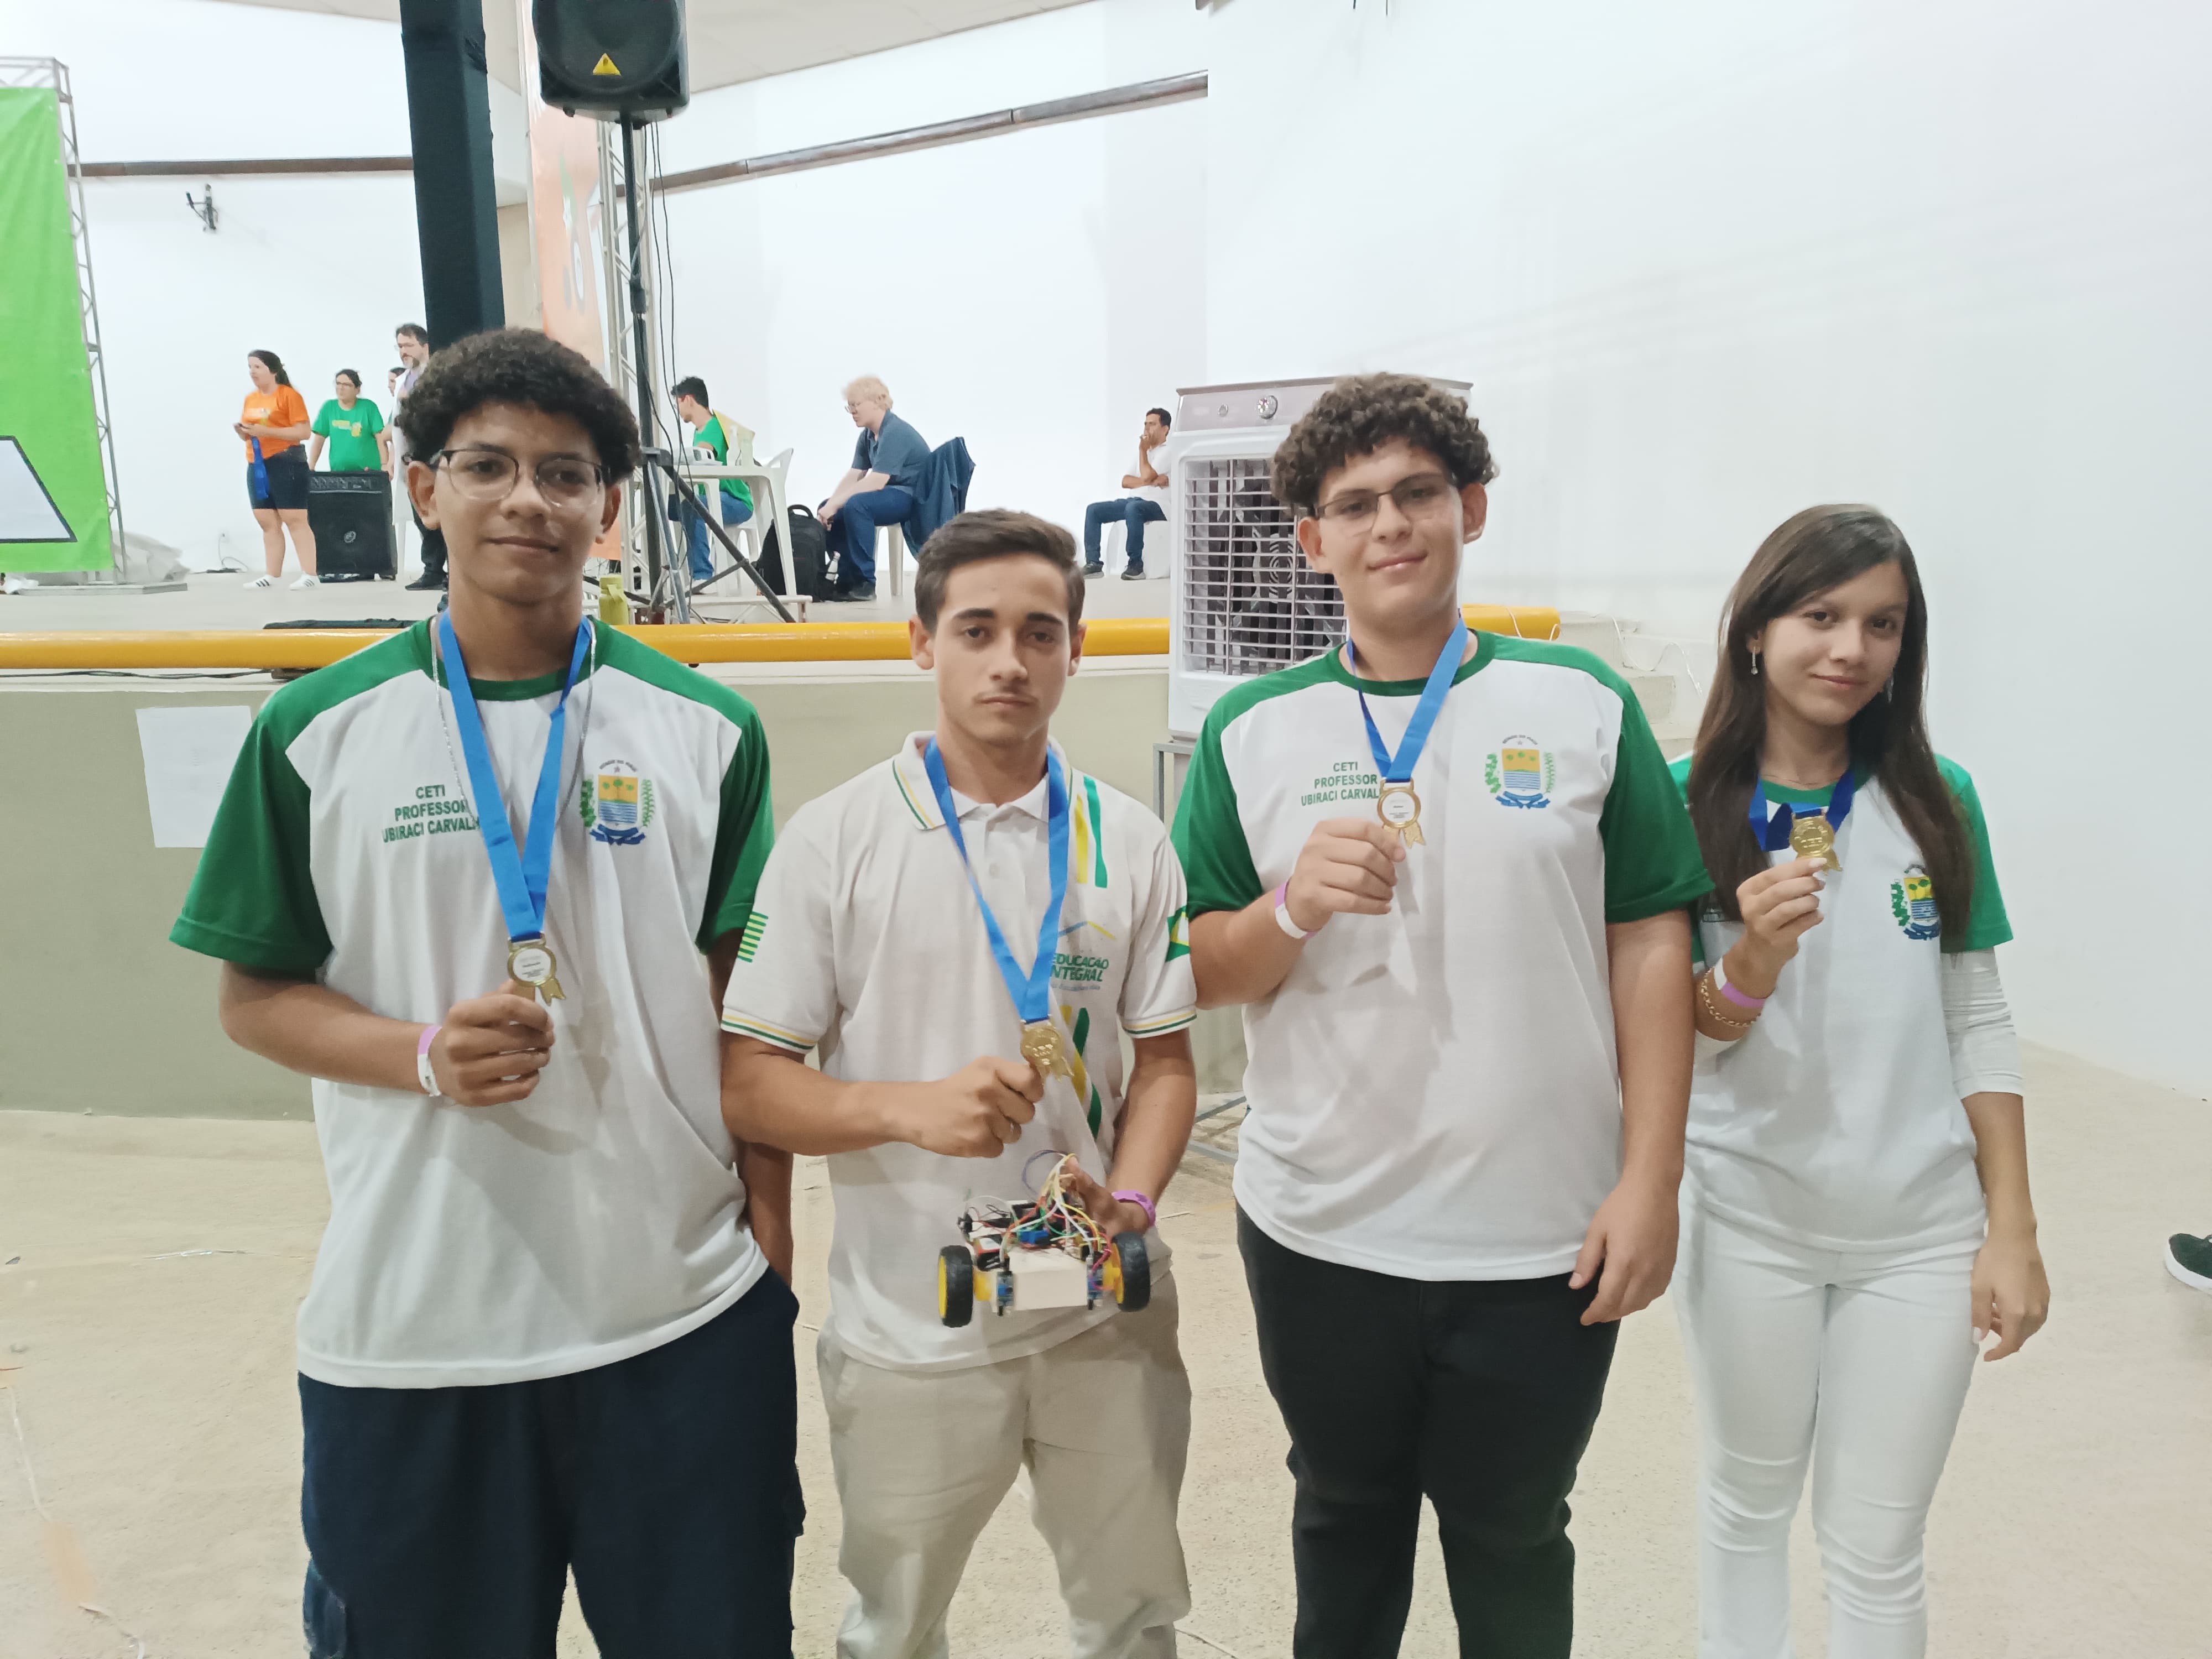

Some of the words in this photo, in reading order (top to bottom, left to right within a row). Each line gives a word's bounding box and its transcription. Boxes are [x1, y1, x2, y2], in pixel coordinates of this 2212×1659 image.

[1334, 761, 1358, 771] CETI
[1314, 774, 1377, 789] PROFESSOR
[416, 784, 445, 799] CETI
[1301, 790, 1337, 806] UBIRACI
[1341, 788, 1380, 800] CARVAL
[1051, 965, 1103, 982] NTEGRAL
